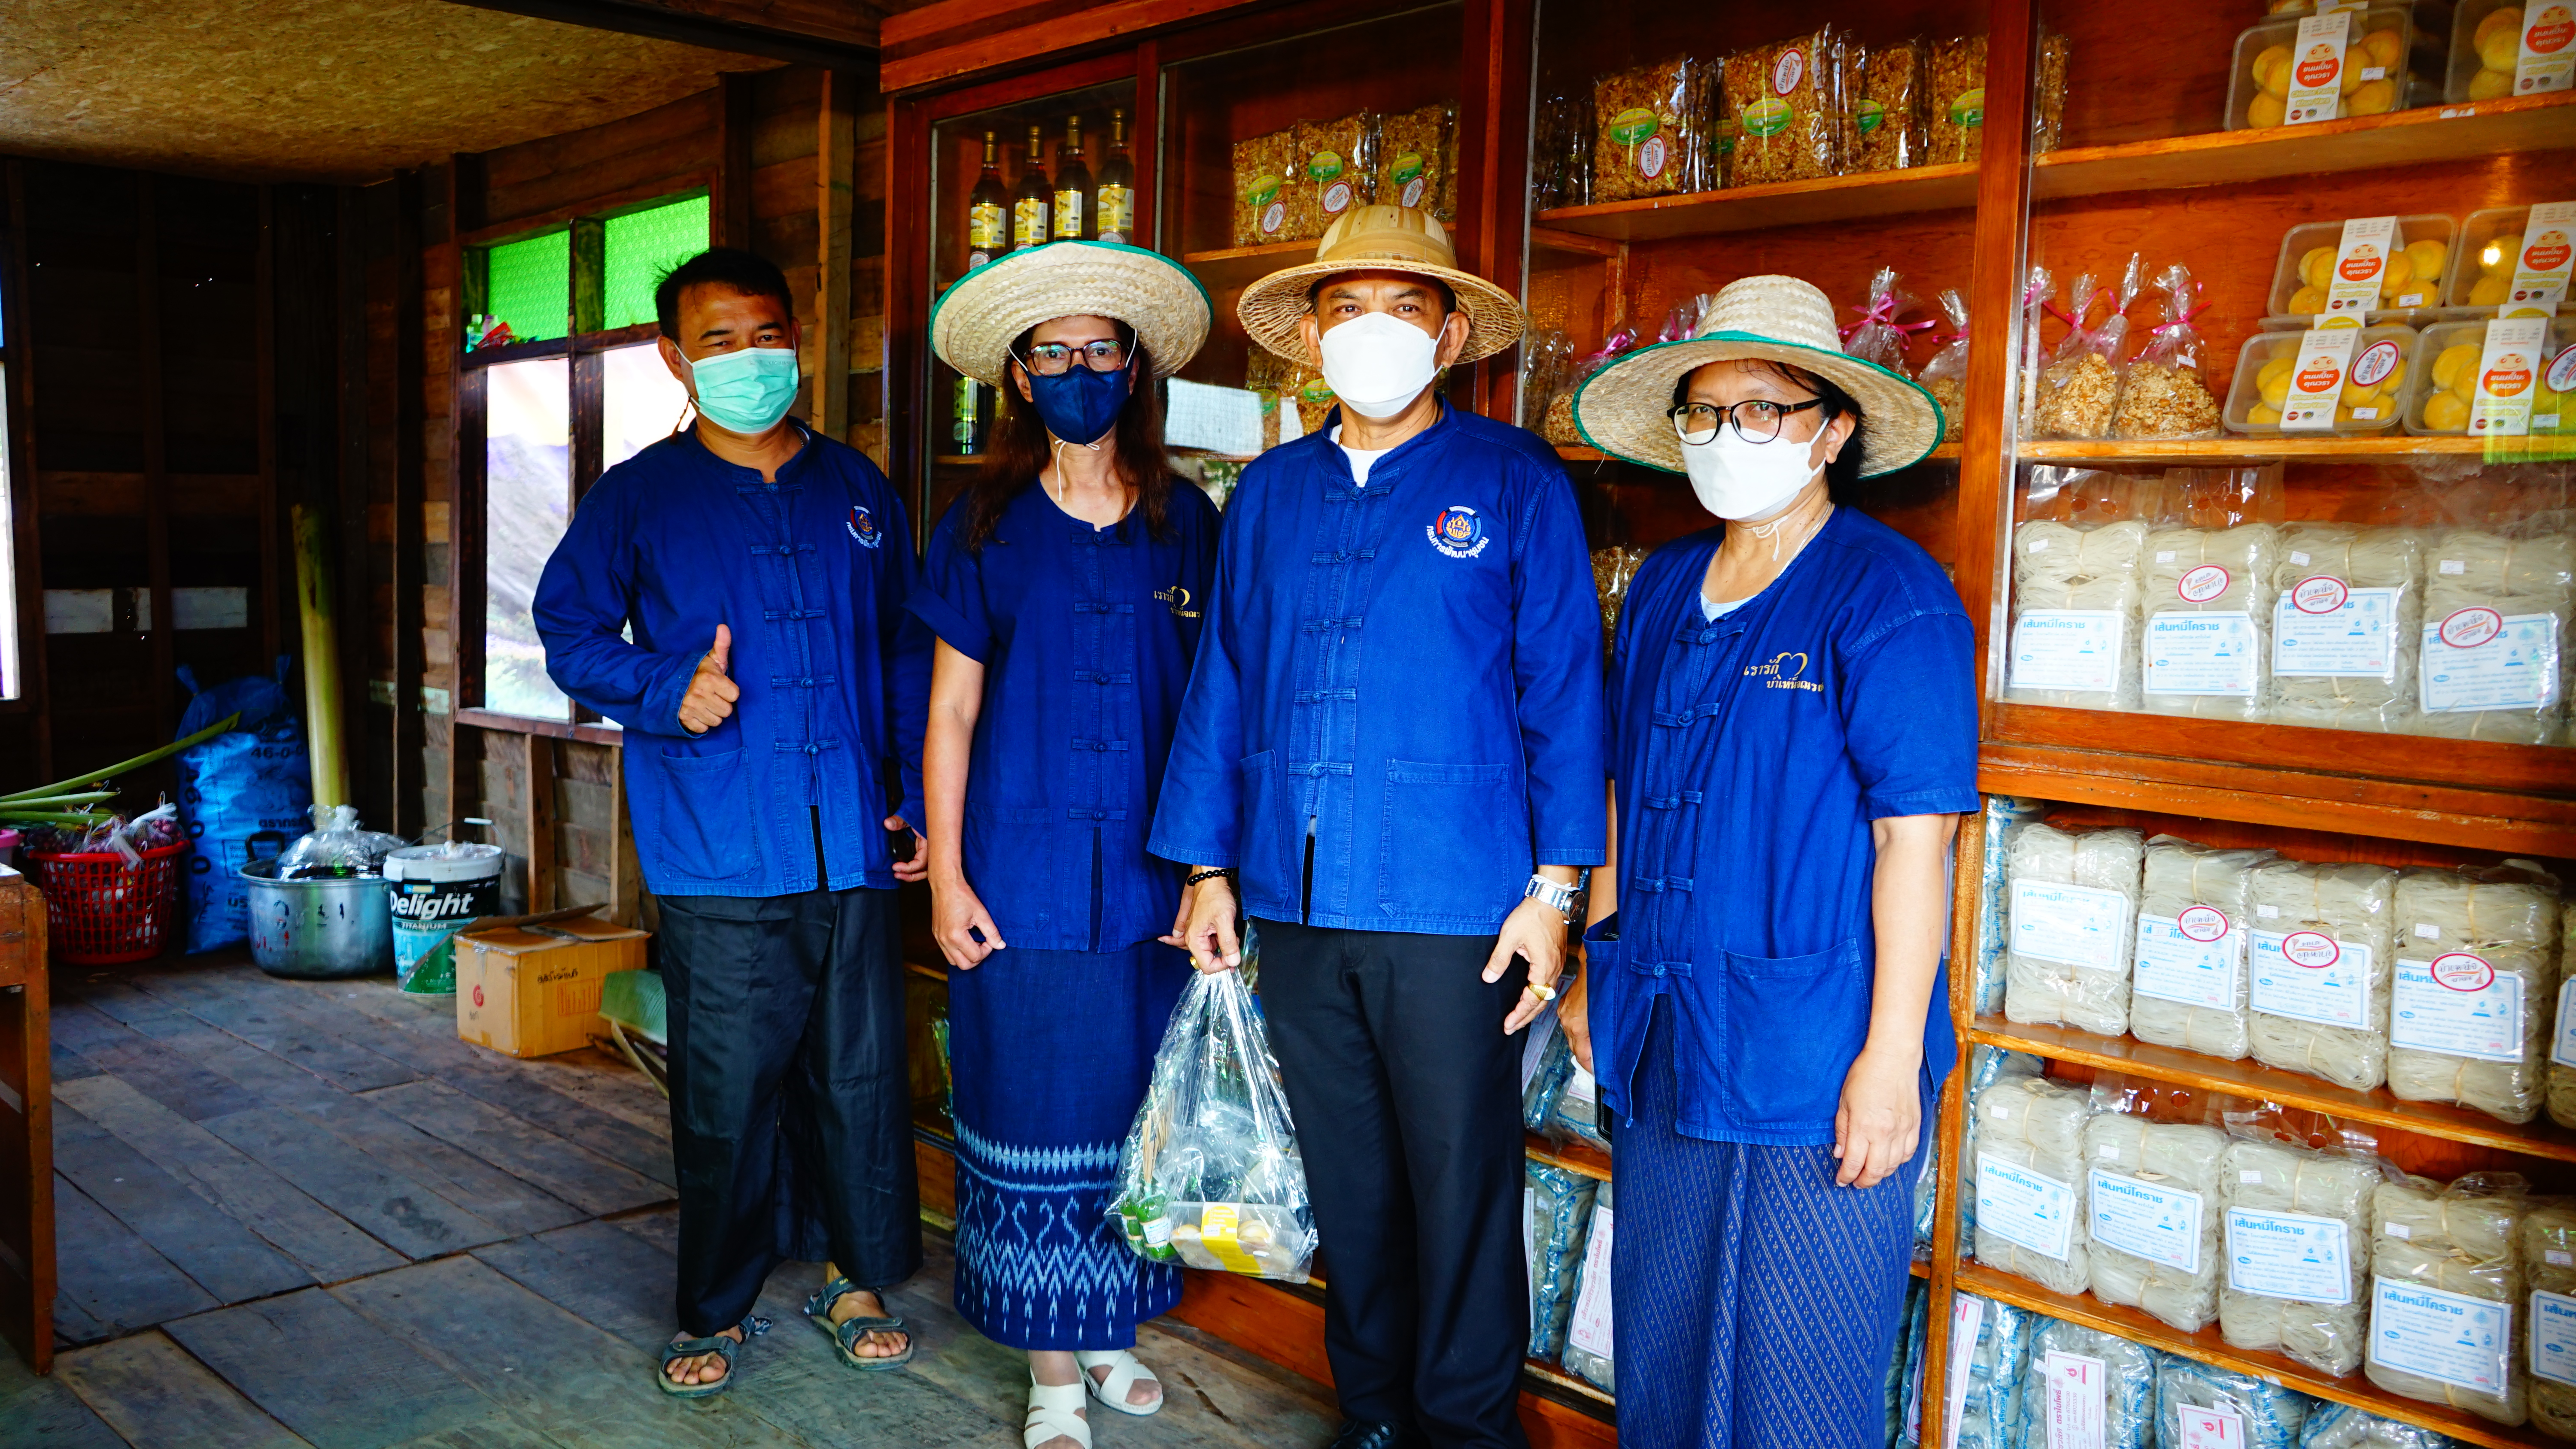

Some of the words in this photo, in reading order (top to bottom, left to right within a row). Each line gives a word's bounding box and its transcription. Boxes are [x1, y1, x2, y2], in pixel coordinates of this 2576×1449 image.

[1426, 526, 1489, 558] กรมการพัฒนาชุมชน
[1154, 589, 1174, 603] เรารัก
[2023, 618, 2086, 630] เส้นหมี่โคราช
[2154, 619, 2220, 632] เส้นหมี่โคราช
[1743, 659, 1780, 676] เรารัก
[390, 893, 474, 921] Delight
[401, 922, 447, 931] TITANIUM
[1984, 1162, 2044, 1192] เส้นหมี่โคราช
[2097, 1178, 2163, 1203] เส้นหมี่โคราช
[2235, 1216, 2306, 1236] เส้นหมี่โคราช
[2384, 1289, 2464, 1316] เส้นหมี่โคราช
[2053, 1388, 2062, 1425] ตราใบโพธิ์
